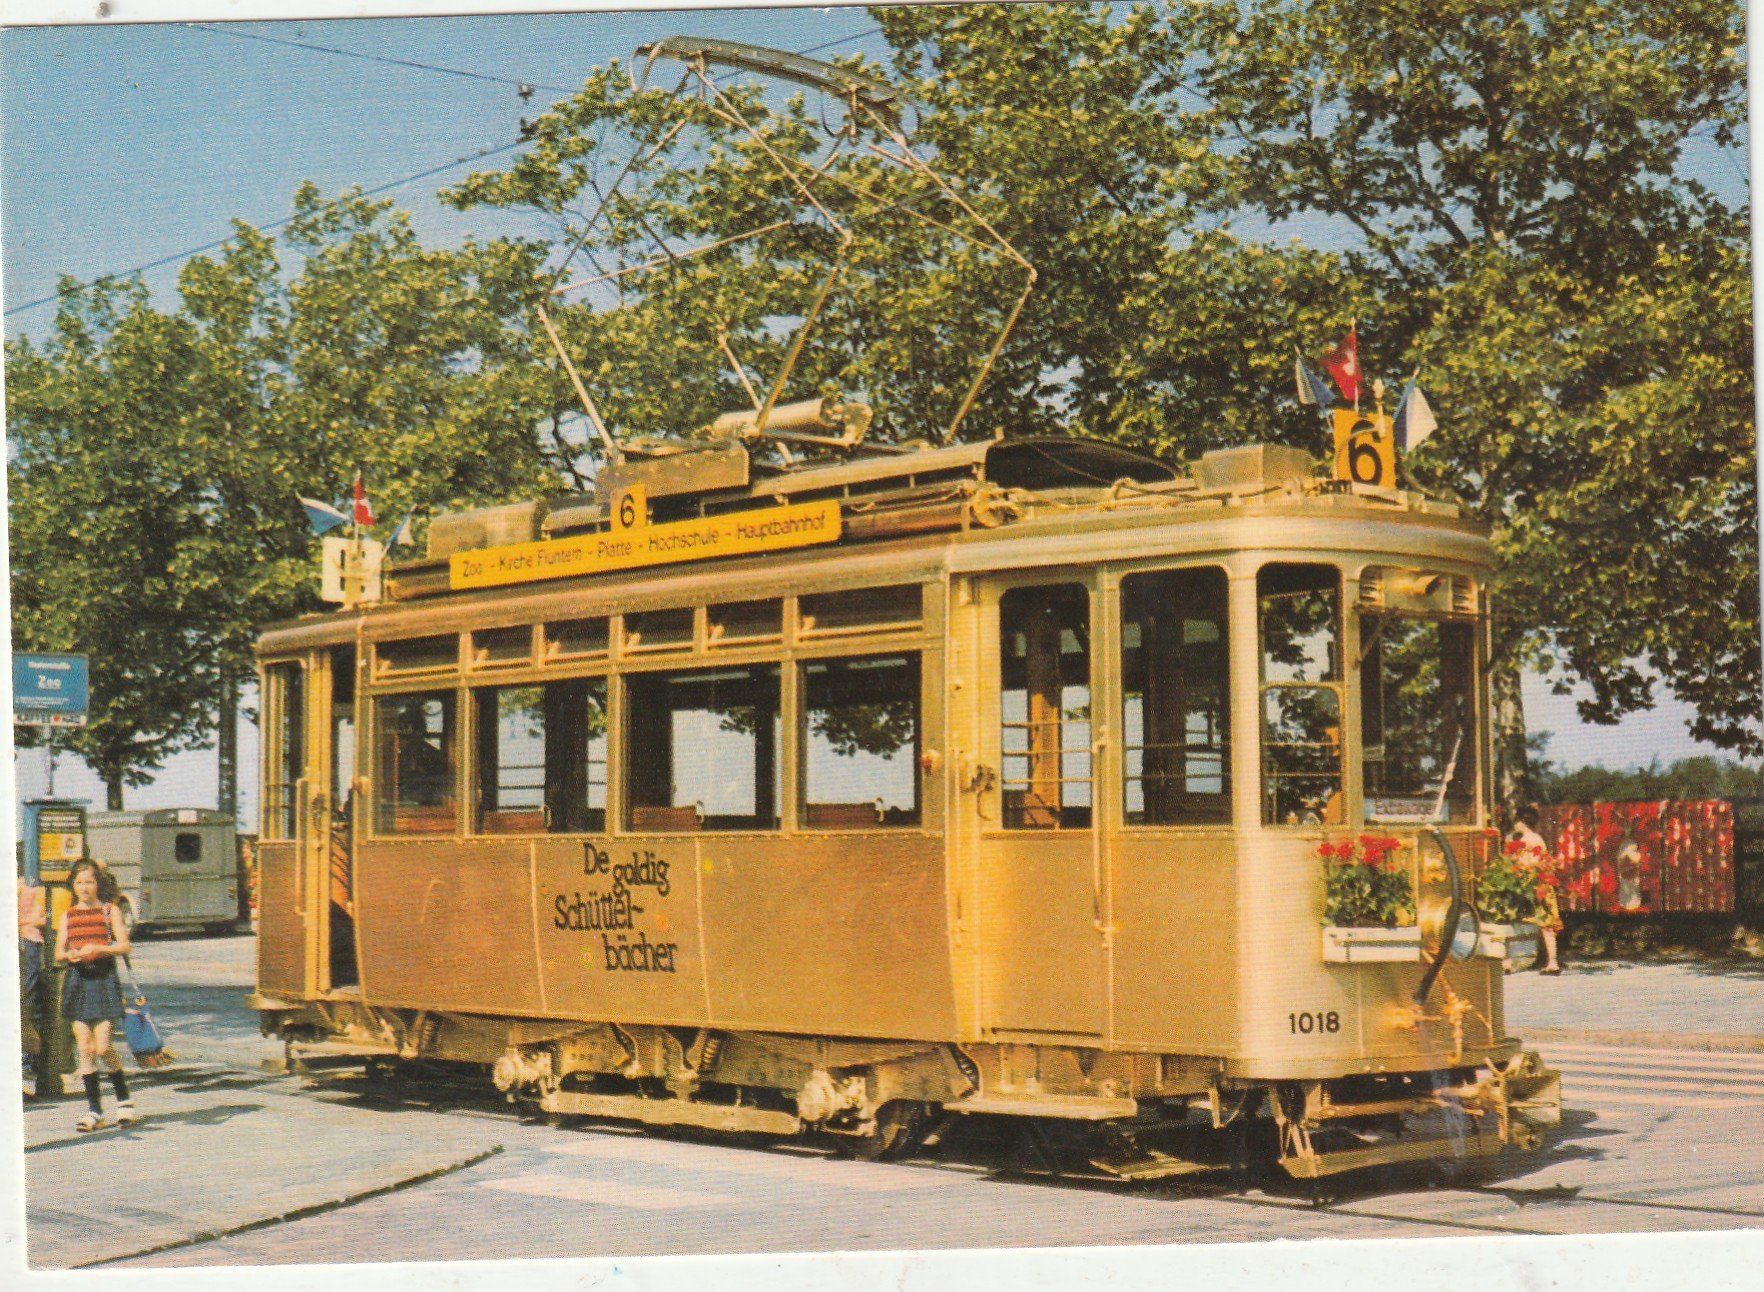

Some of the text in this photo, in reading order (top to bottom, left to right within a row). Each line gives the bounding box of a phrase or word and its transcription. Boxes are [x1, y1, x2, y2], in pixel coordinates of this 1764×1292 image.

[1348, 419, 1382, 487] 6
[620, 493, 636, 529] 6
[463, 560, 482, 577] Zoo
[648, 529, 720, 552] Hochschule
[737, 509, 826, 541] Hauptbahnhof
[583, 842, 610, 875] De
[612, 851, 671, 898] goldig
[601, 931, 679, 973] bächer
[1289, 1011, 1340, 1034] 1018
